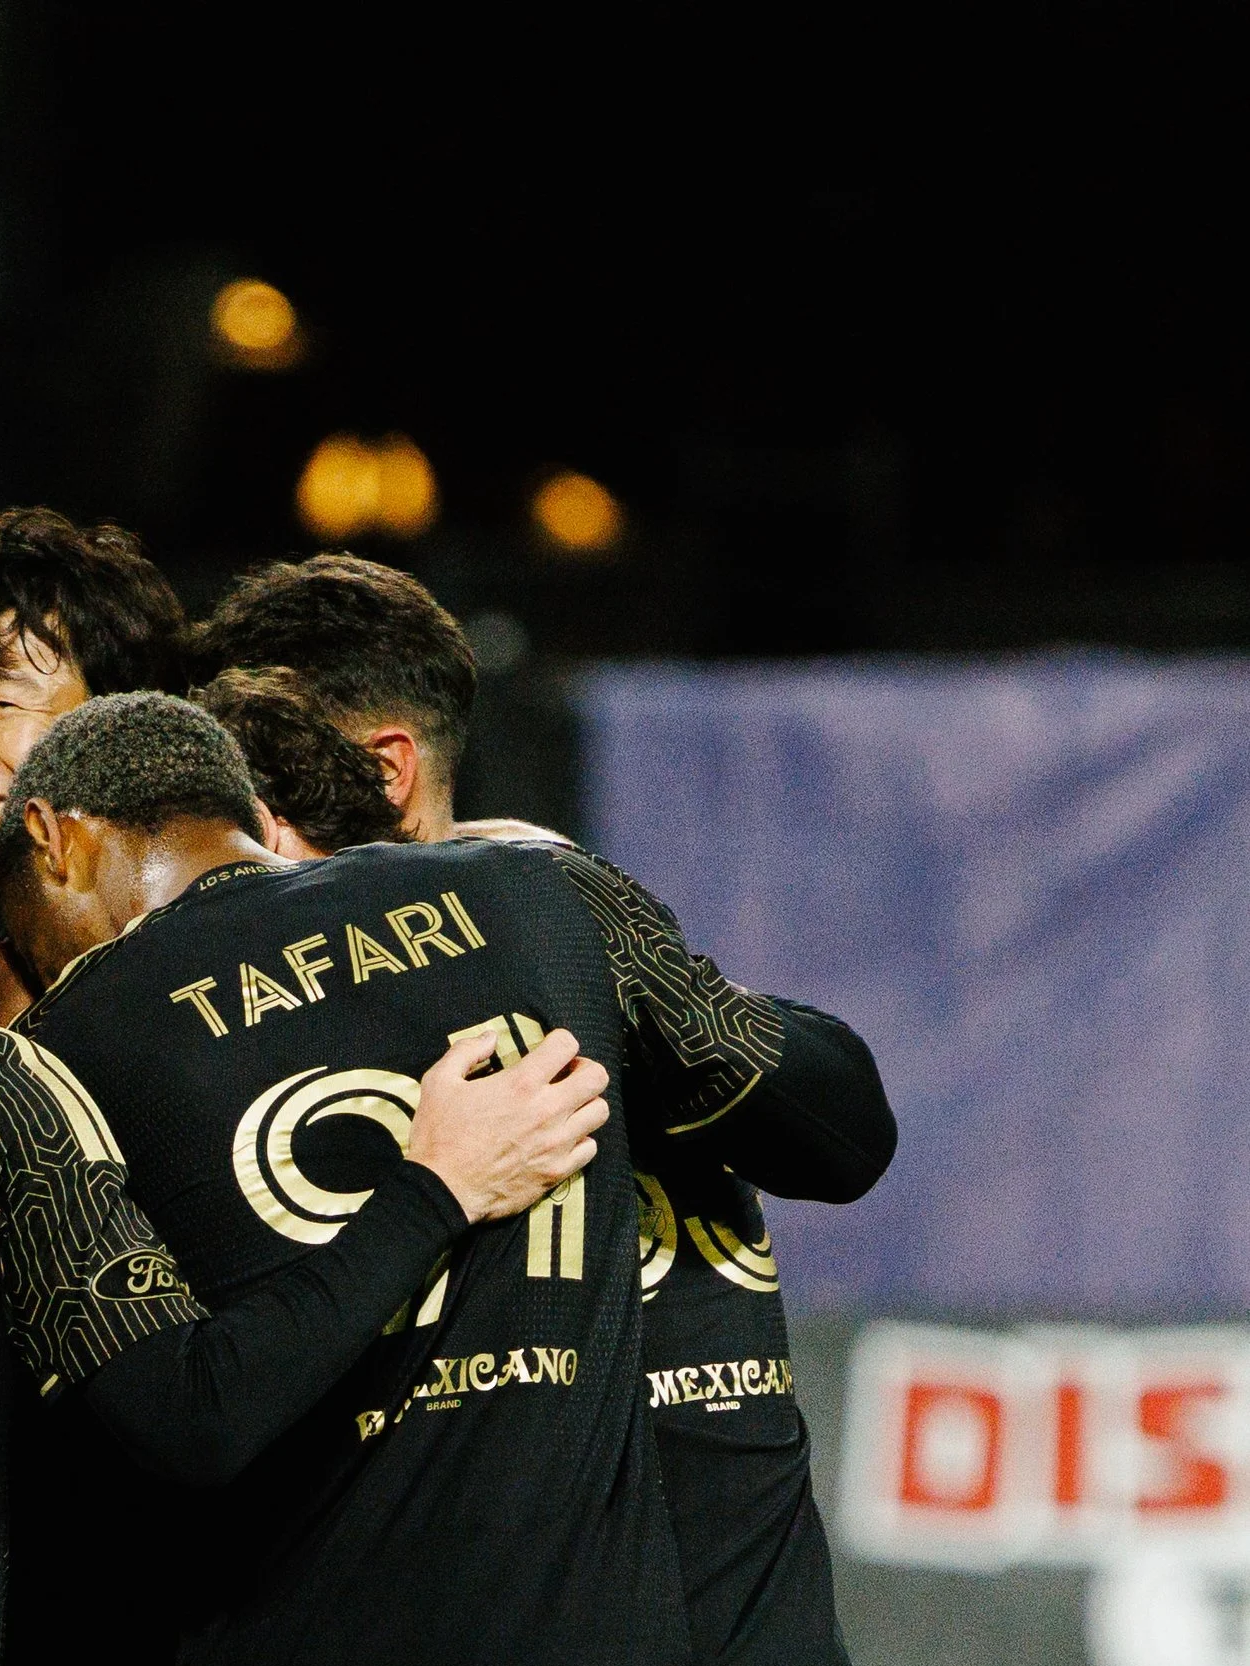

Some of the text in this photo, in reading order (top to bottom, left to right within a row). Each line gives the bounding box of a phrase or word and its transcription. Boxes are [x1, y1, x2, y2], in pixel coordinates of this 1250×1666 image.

[198, 870, 231, 891] LOS
[169, 891, 487, 1039] TAFARI
[394, 1348, 578, 1423] XICANO
[646, 1359, 793, 1408] MEXICAN
[426, 1399, 462, 1411] BRAND
[705, 1401, 741, 1412] BRAND
